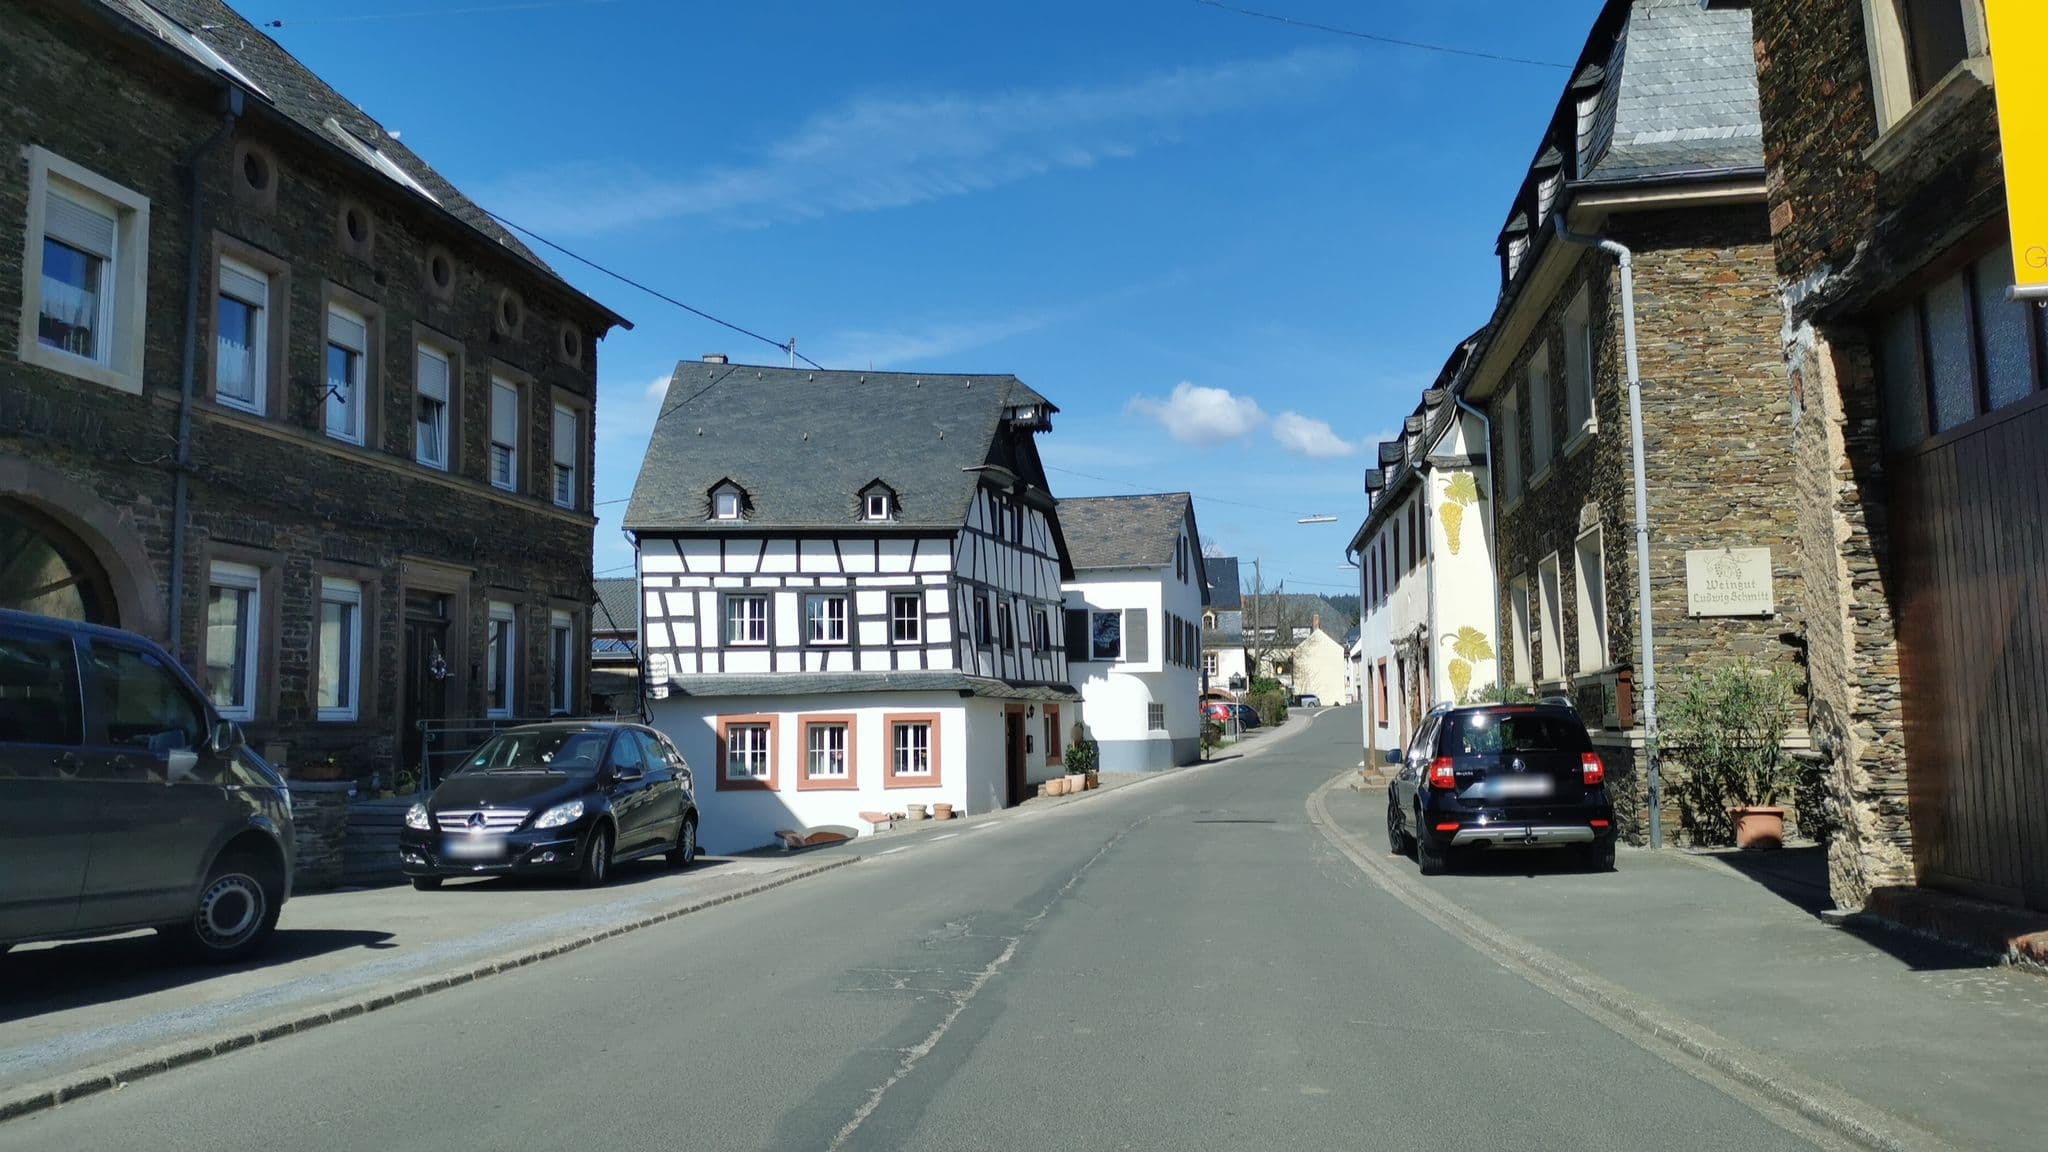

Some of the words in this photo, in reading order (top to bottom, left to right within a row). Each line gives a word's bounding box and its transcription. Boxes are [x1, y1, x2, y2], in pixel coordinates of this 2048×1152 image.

[1706, 580, 1756, 590] Weingut
[1693, 593, 1729, 604] Ludwig
[1730, 591, 1769, 601] Schmitt
